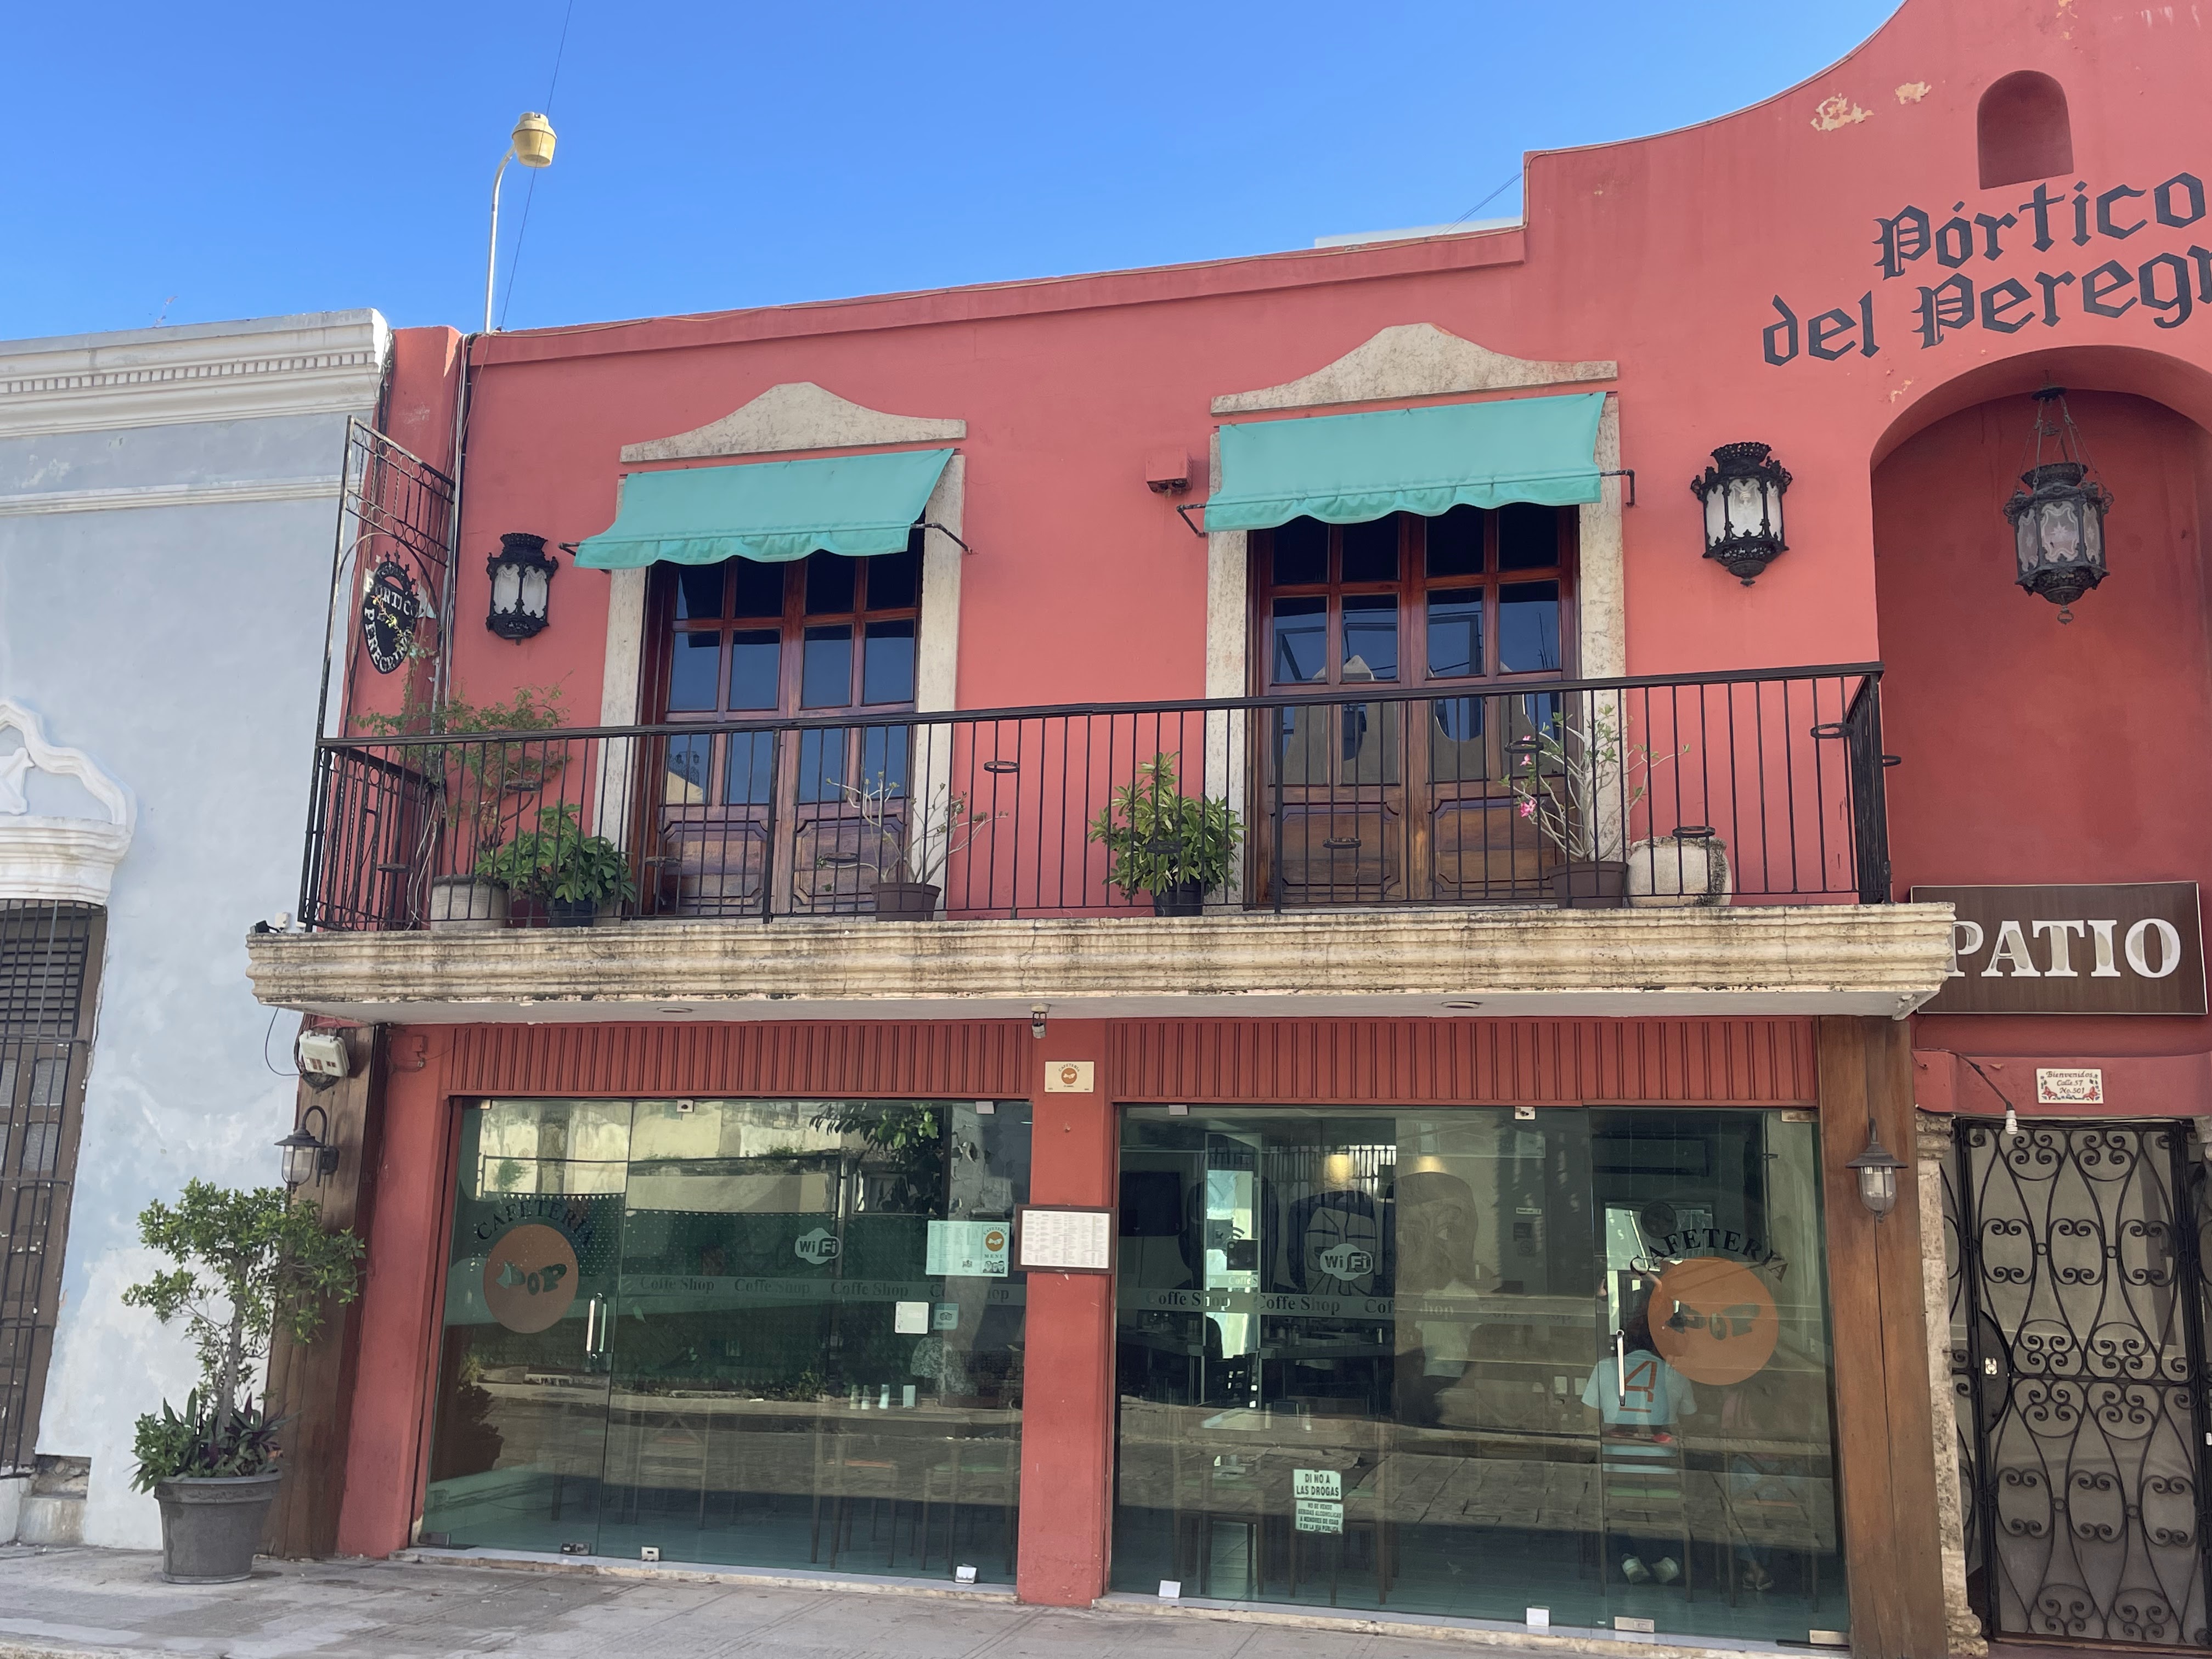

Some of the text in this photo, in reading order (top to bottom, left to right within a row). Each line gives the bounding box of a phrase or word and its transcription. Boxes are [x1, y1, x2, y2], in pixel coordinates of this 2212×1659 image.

[1872, 172, 2207, 281] Pórtico
[1762, 290, 1881, 366] del
[1946, 918, 2181, 978] PATIO
[1058, 1063, 1080, 1072] CAFETERIA
[2046, 1070, 2093, 1079] Bienvenidos
[477, 1199, 593, 1246] CAFETERIA
[1630, 1228, 1788, 1283] CAFETERIA
[680, 1277, 715, 1294] Shop
[734, 1278, 772, 1293] Coffe
[831, 1281, 869, 1295] Coffe
[873, 1282, 909, 1297] Shop
[1296, 1485, 1339, 1497] LAS DROGAS
[1305, 1473, 1330, 1484] DI NO A
